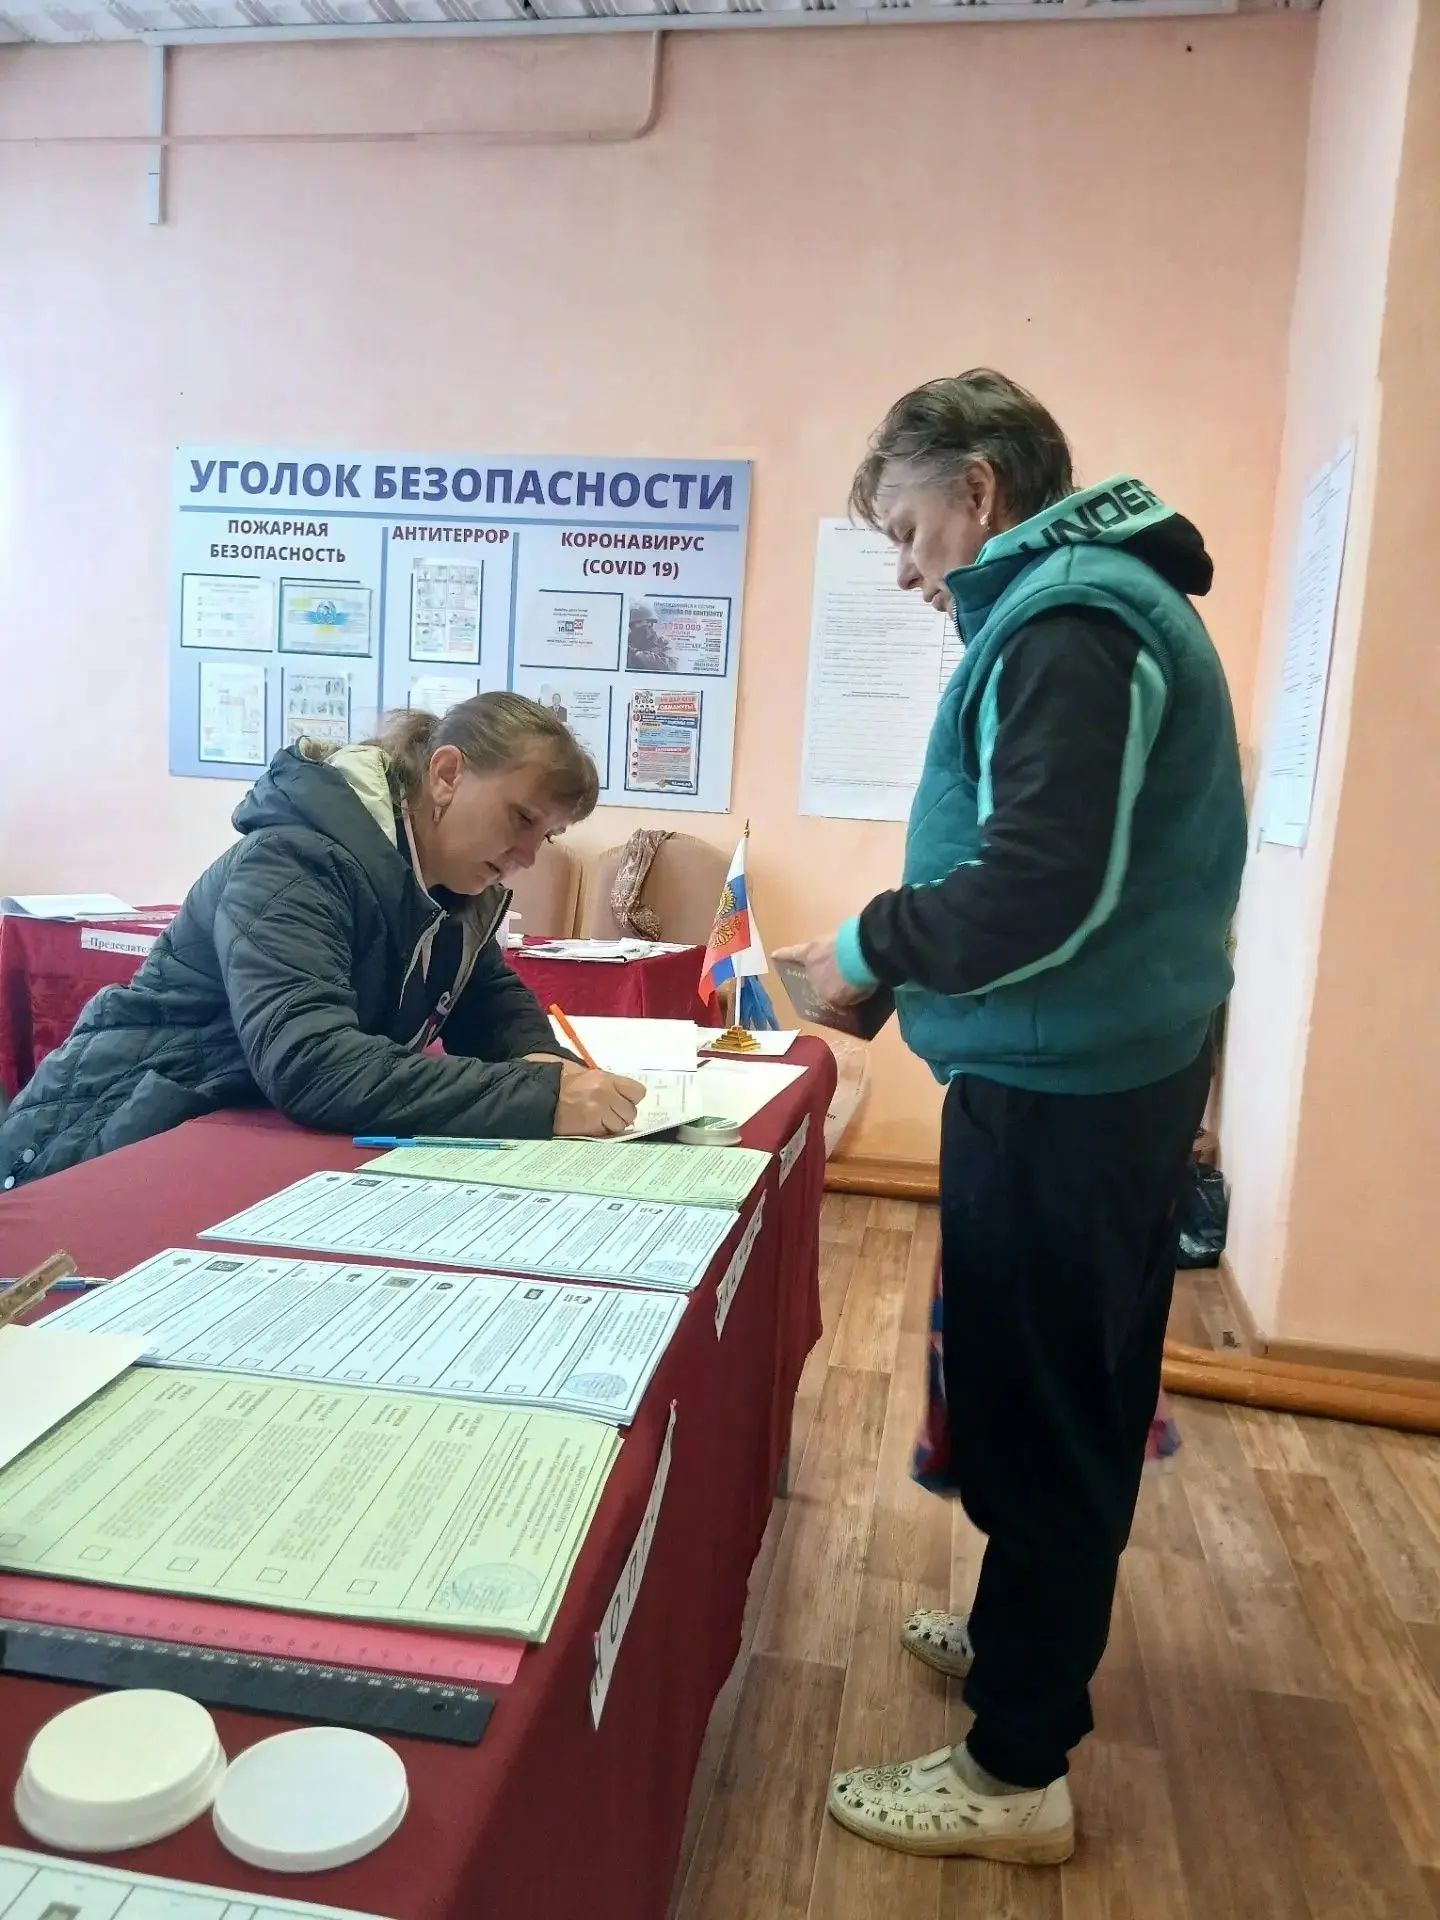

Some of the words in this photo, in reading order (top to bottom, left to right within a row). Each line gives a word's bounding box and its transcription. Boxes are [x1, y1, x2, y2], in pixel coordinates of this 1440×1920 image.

[190, 459, 362, 498] УГОЛОК
[374, 466, 733, 511] БЕЗОПАСНОСТИ
[228, 519, 329, 537] ПОЖАРНАЯ
[391, 525, 510, 545] АНТИТЕРРОР
[560, 532, 705, 552] КОРОНАВИРУС
[209, 543, 346, 563] БЕЗОПАСНОСТЬ
[582, 558, 646, 577] (COVID
[652, 561, 680, 580] 19)
[90, 937, 153, 954] Председате
